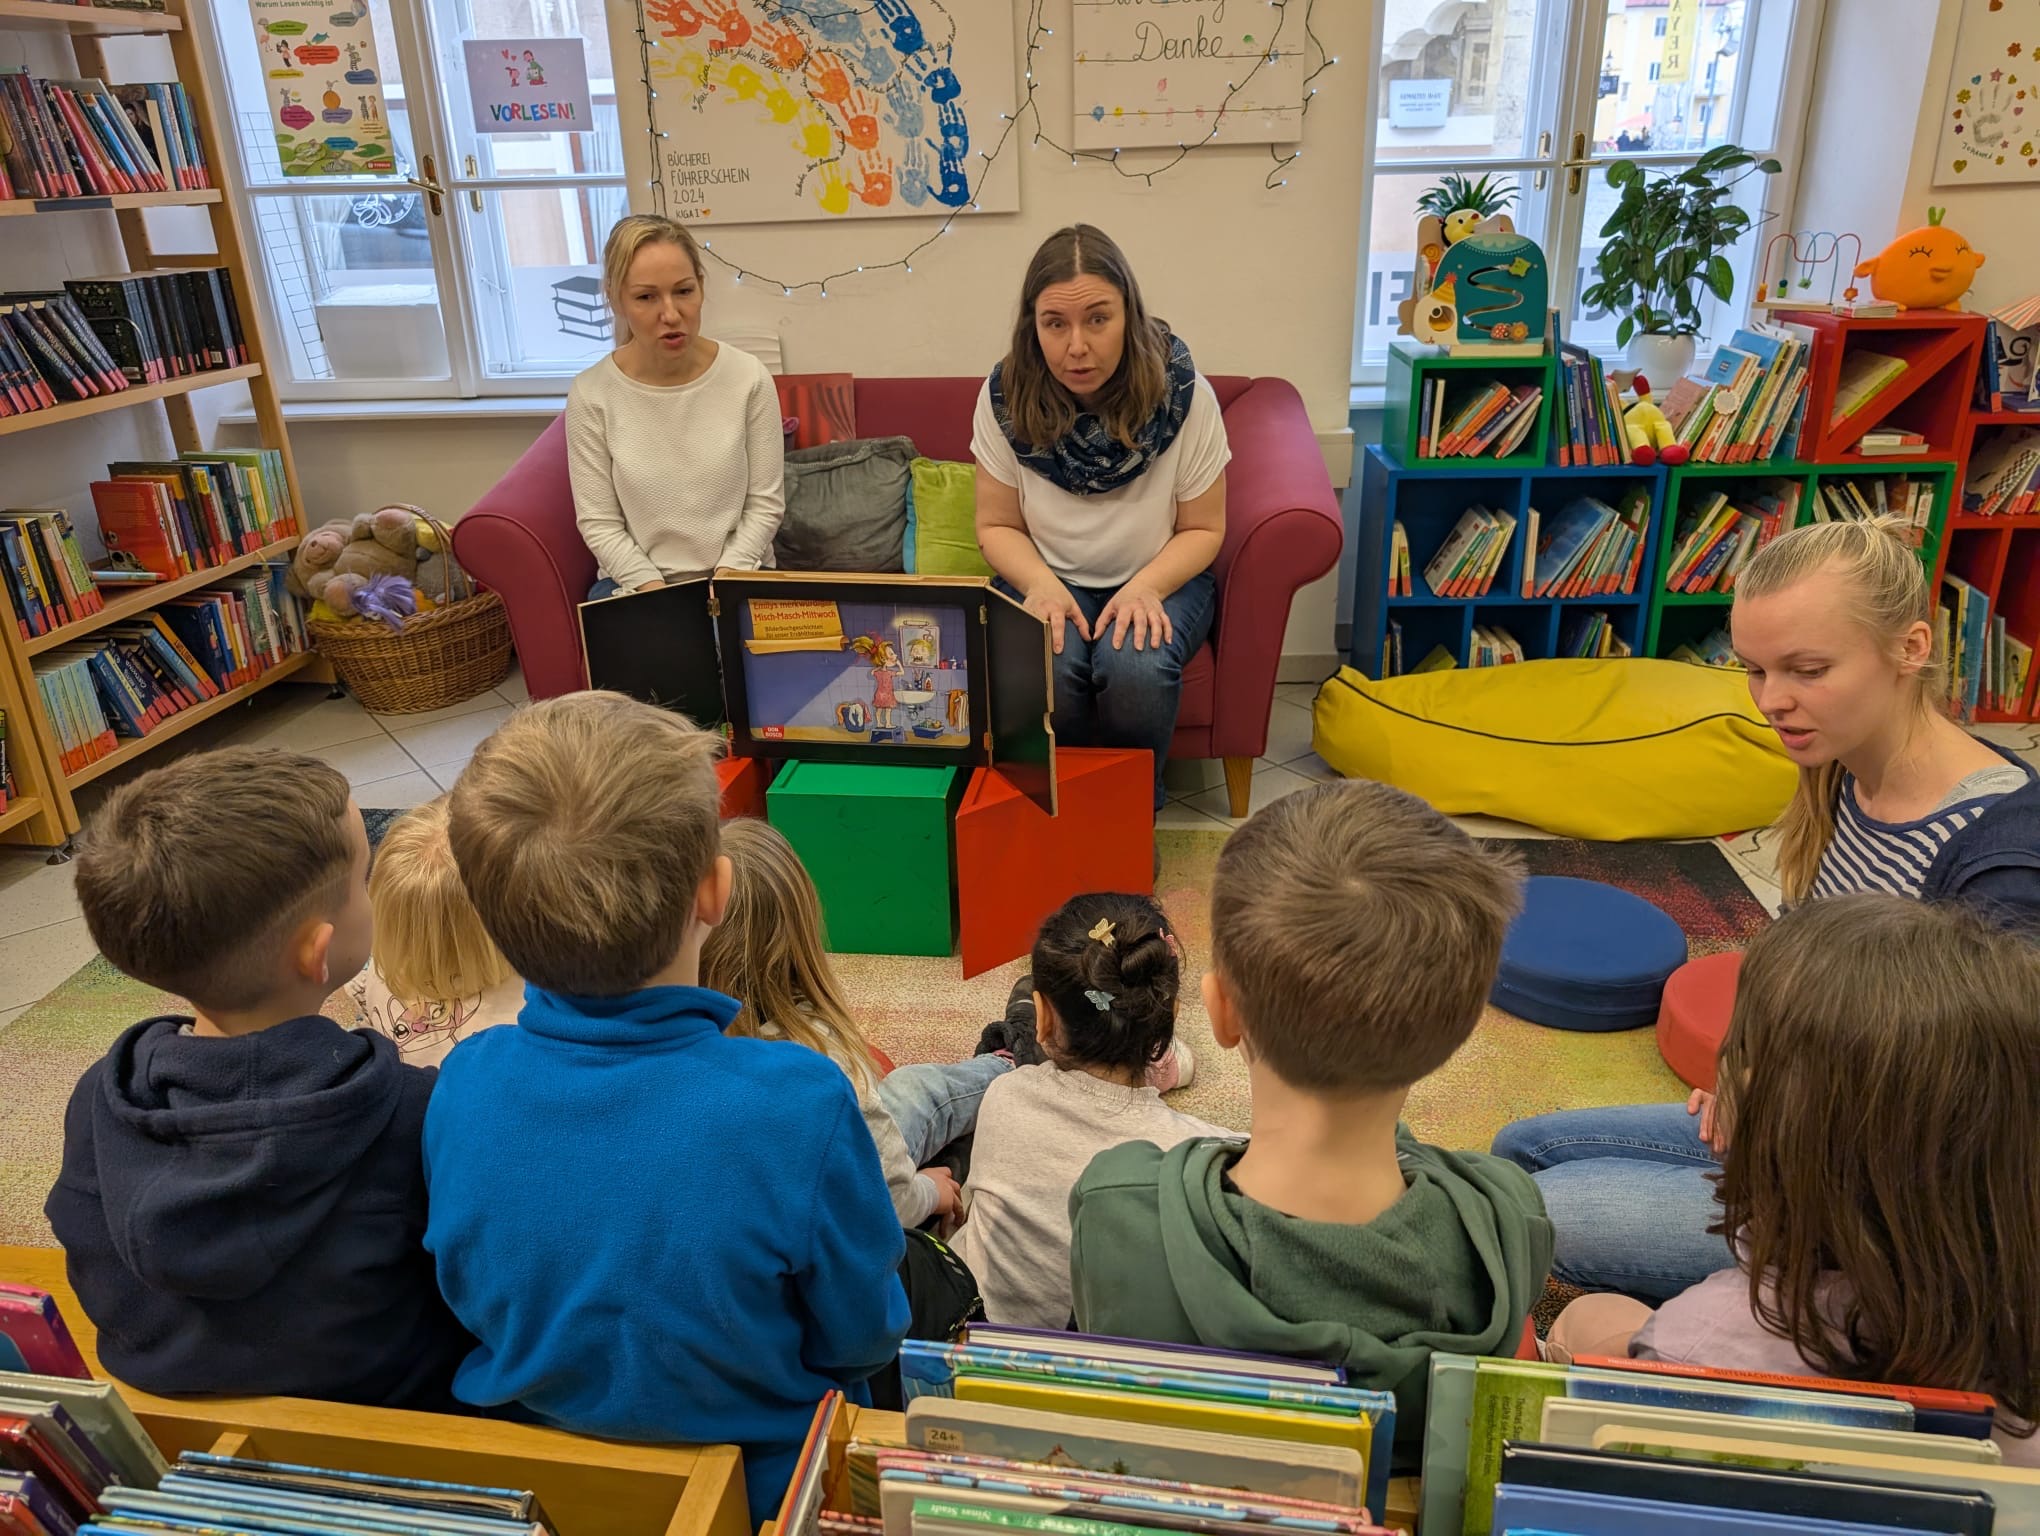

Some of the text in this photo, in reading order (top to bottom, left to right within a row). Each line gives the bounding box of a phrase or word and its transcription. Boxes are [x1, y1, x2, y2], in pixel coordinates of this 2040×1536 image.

[1133, 15, 1223, 62] Danke
[490, 102, 576, 122] VORLESEN!
[667, 150, 711, 167] BÜCHEREI
[671, 168, 750, 187] FÜHRERSCHEIN
[673, 187, 705, 205] 2024
[930, 1429, 957, 1441] 24+
